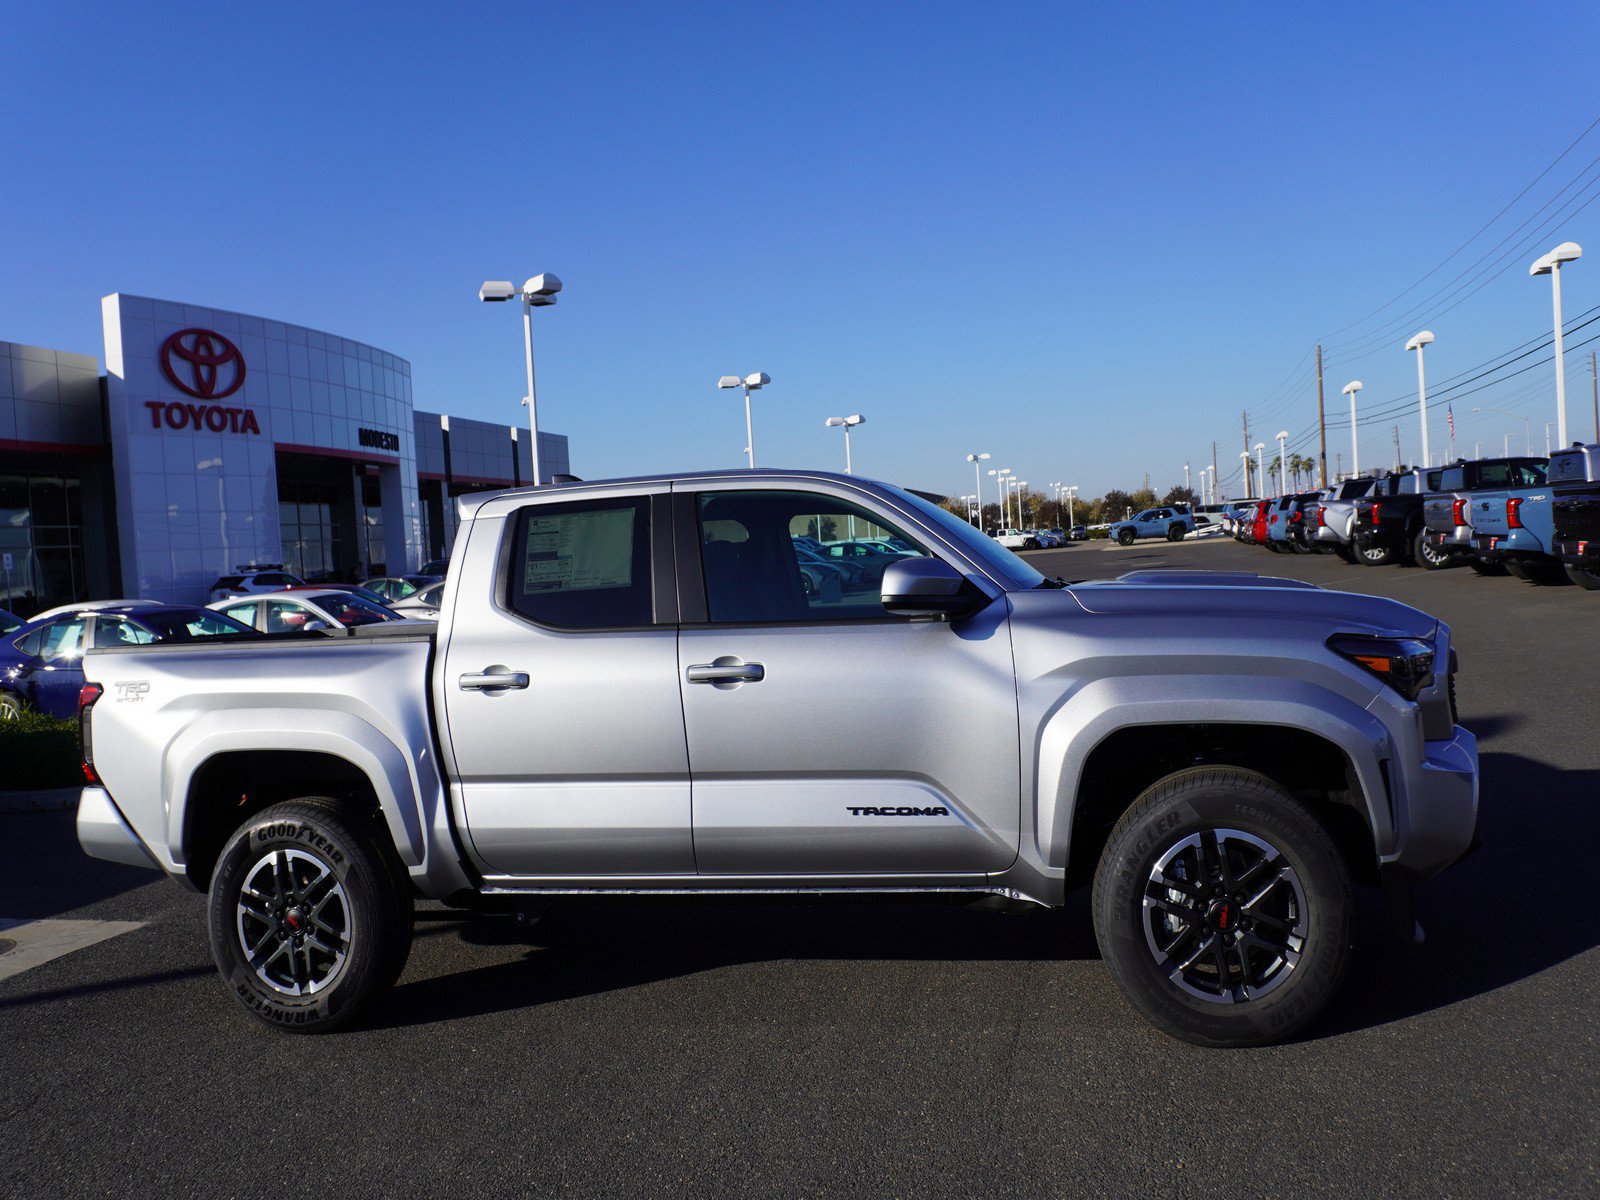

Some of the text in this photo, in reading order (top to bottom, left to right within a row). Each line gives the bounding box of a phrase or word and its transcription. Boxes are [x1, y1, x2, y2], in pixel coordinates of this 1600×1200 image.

[144, 401, 260, 434] TOYOTA
[358, 427, 399, 452] MODESTO
[114, 680, 150, 697] TRD
[846, 806, 950, 816] TACOMA
[1232, 804, 1299, 840] TERRITORY
[257, 823, 346, 866] GOODYEAR
[1117, 810, 1181, 921] WRANGLER
[235, 983, 321, 1025] WRANGLER
